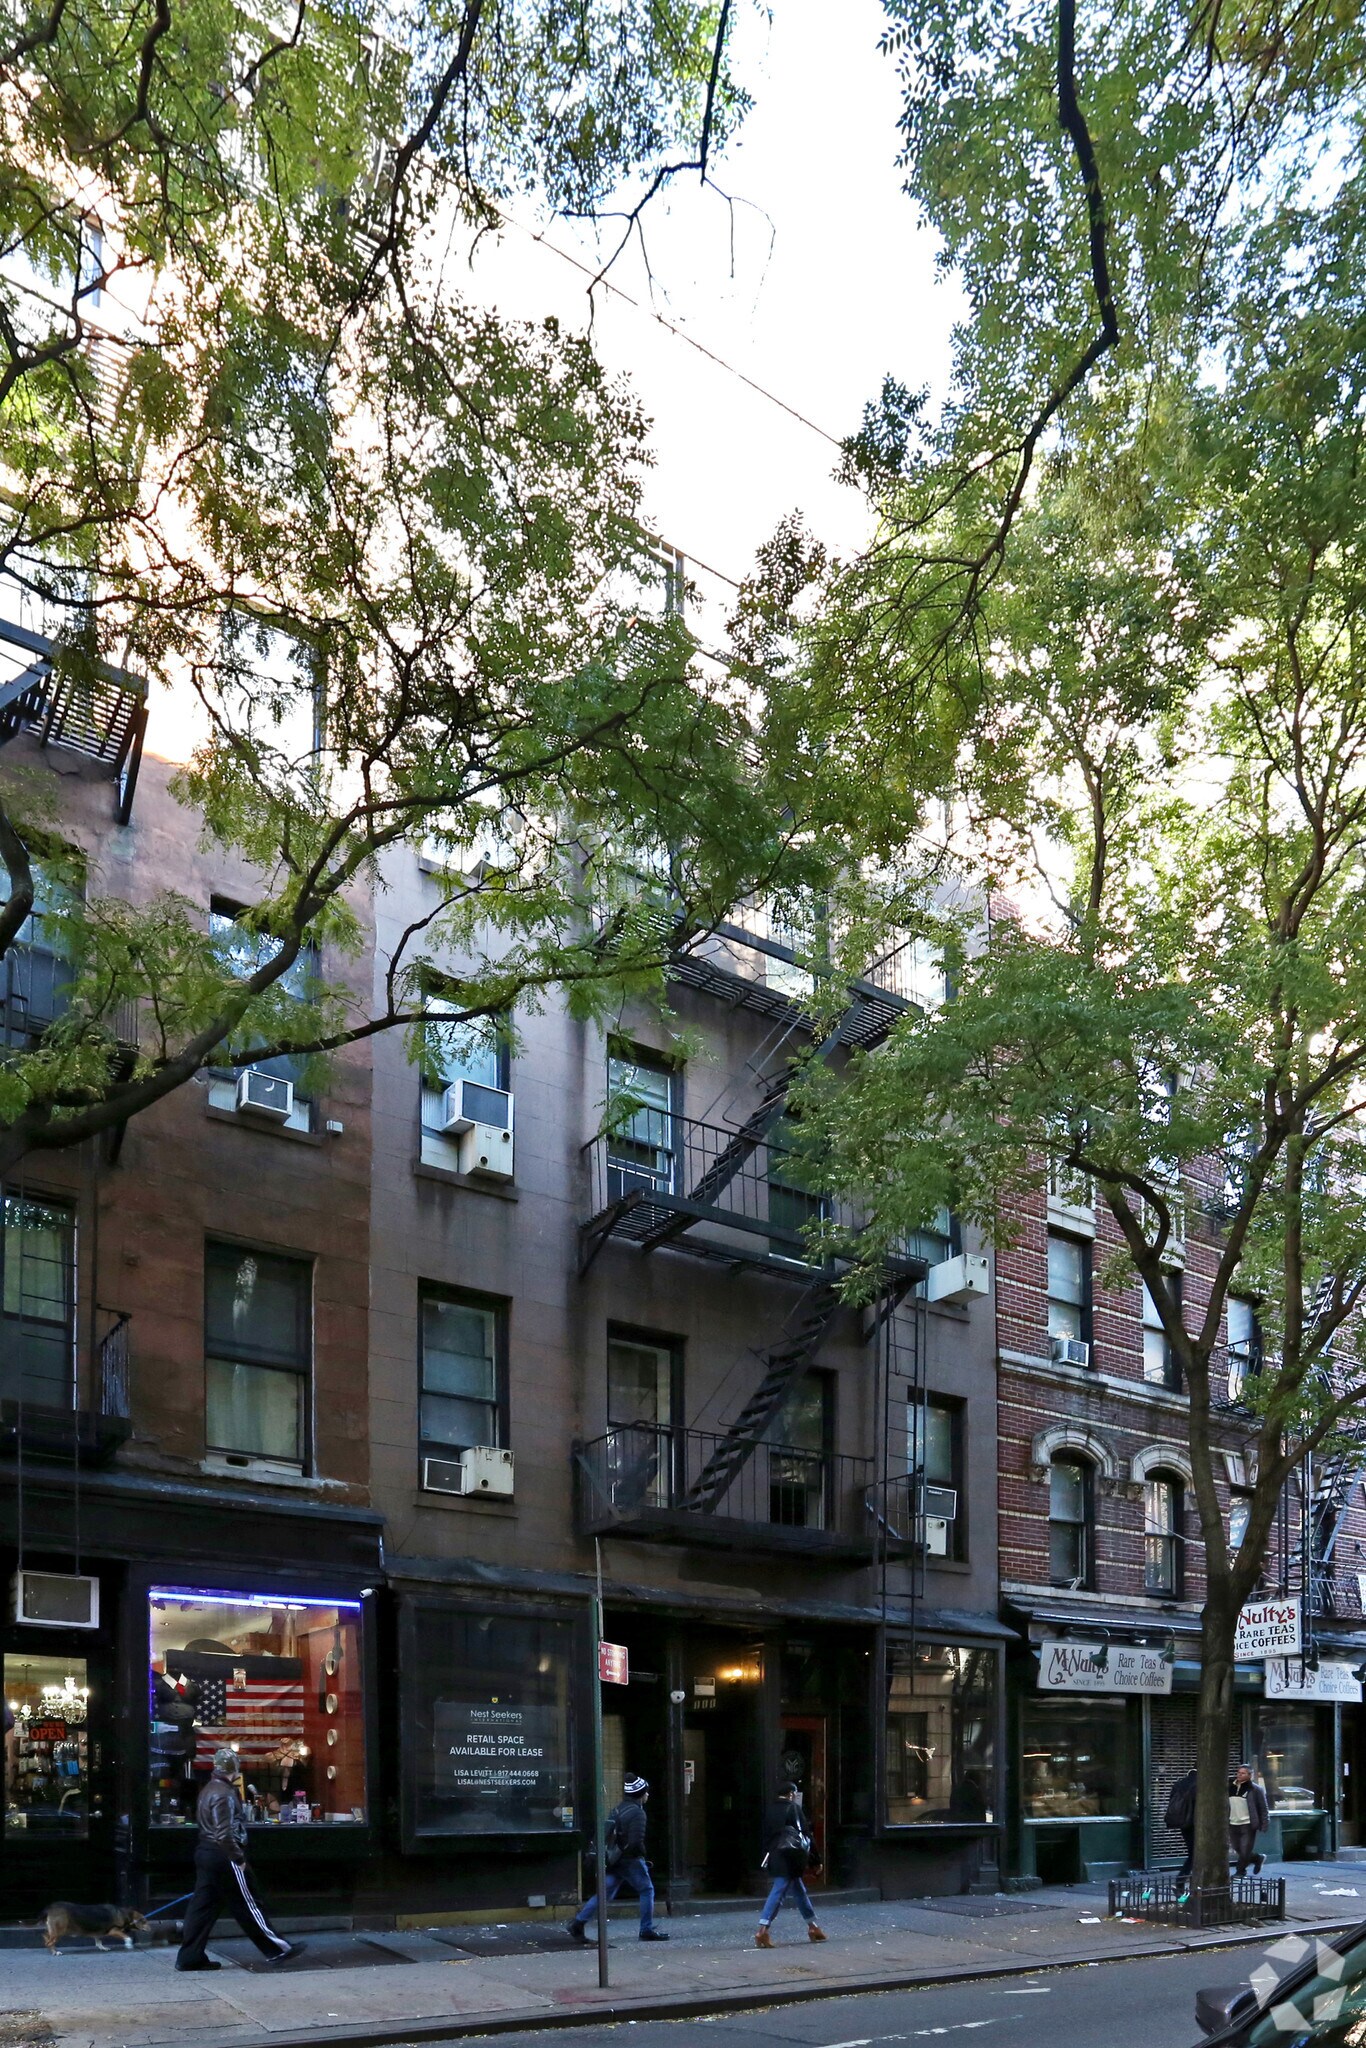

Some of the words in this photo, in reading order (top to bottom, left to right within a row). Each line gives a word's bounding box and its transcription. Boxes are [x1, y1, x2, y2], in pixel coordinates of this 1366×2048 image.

[1238, 1605, 1296, 1630] Nulty's
[1240, 1629, 1265, 1640] RARE
[1268, 1623, 1295, 1636] TEAS
[1234, 1641, 1250, 1651] ICE
[1251, 1634, 1296, 1648] COFFEES
[1234, 1651, 1254, 1659] SINCE
[1118, 1653, 1135, 1669] Rare
[1140, 1654, 1157, 1670] Teas
[1113, 1670, 1138, 1686] Choice
[1140, 1671, 1165, 1688] Coffees
[1319, 1681, 1338, 1693] Choice
[470, 1710, 489, 1718] Nest
[490, 1710, 522, 1720] Seekers
[29, 1727, 66, 1740] OPEN
[466, 1734, 496, 1744] RETAIL
[497, 1735, 524, 1744] SPACE
[449, 1746, 497, 1756] AVAILABLE
[498, 1747, 516, 1756] FOR
[517, 1748, 543, 1757] LEASE
[454, 1769, 469, 1777] LISA
[470, 1769, 493, 1777] LEVITT
